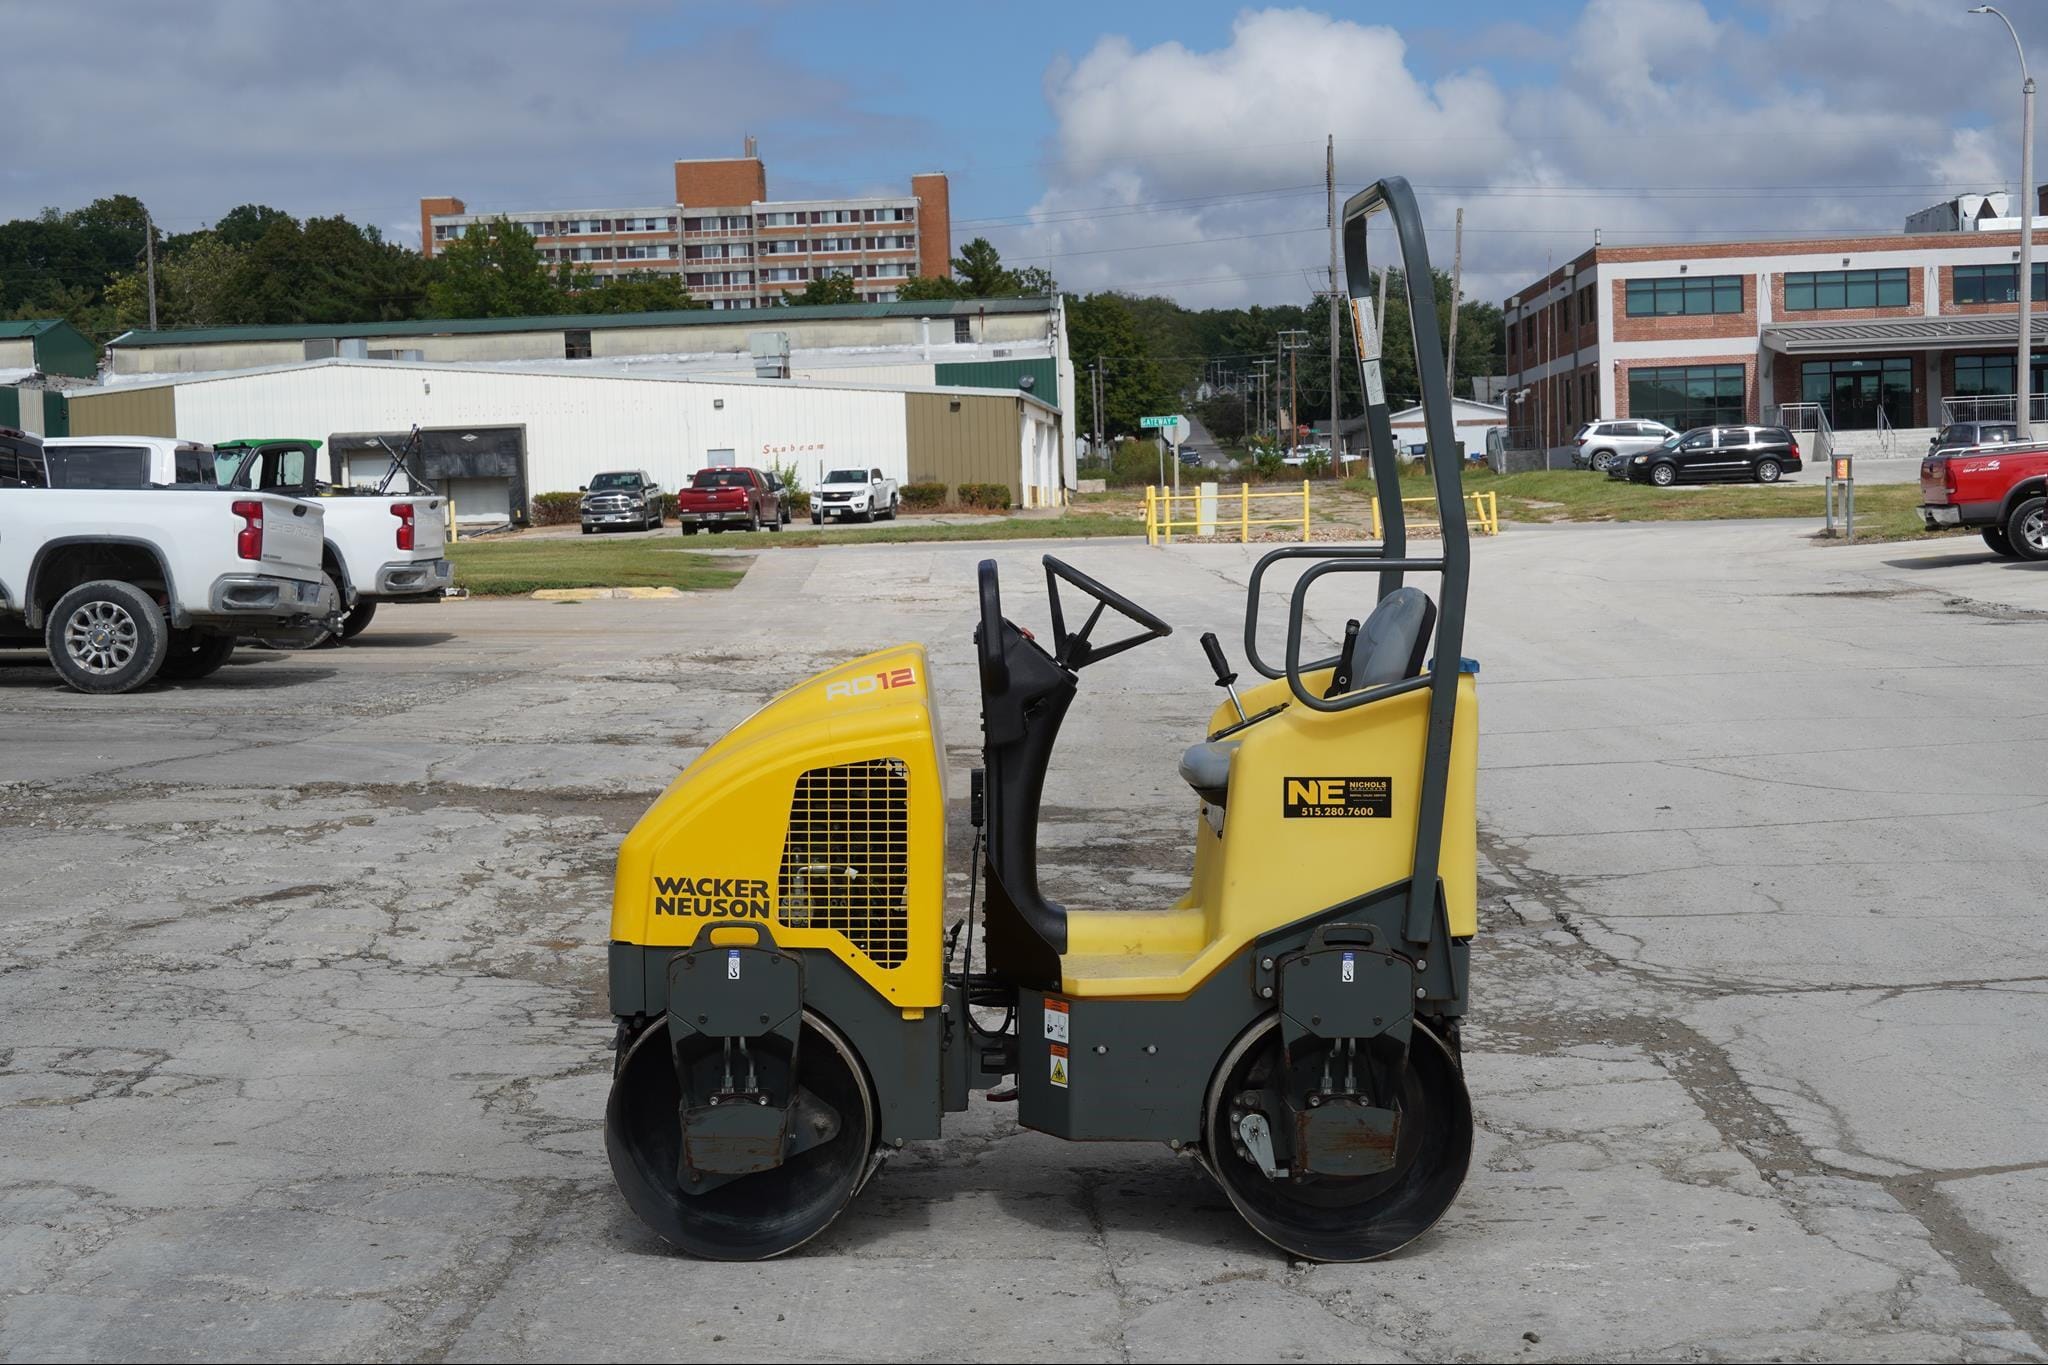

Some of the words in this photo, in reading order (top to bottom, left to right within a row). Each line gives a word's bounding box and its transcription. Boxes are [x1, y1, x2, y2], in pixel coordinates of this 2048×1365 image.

[1142, 416, 1171, 427] GATEWAY
[1288, 780, 1345, 805] NE
[1301, 807, 1374, 816] 515.280.7600
[654, 876, 769, 898] WACKER
[655, 897, 769, 919] NEUSON
